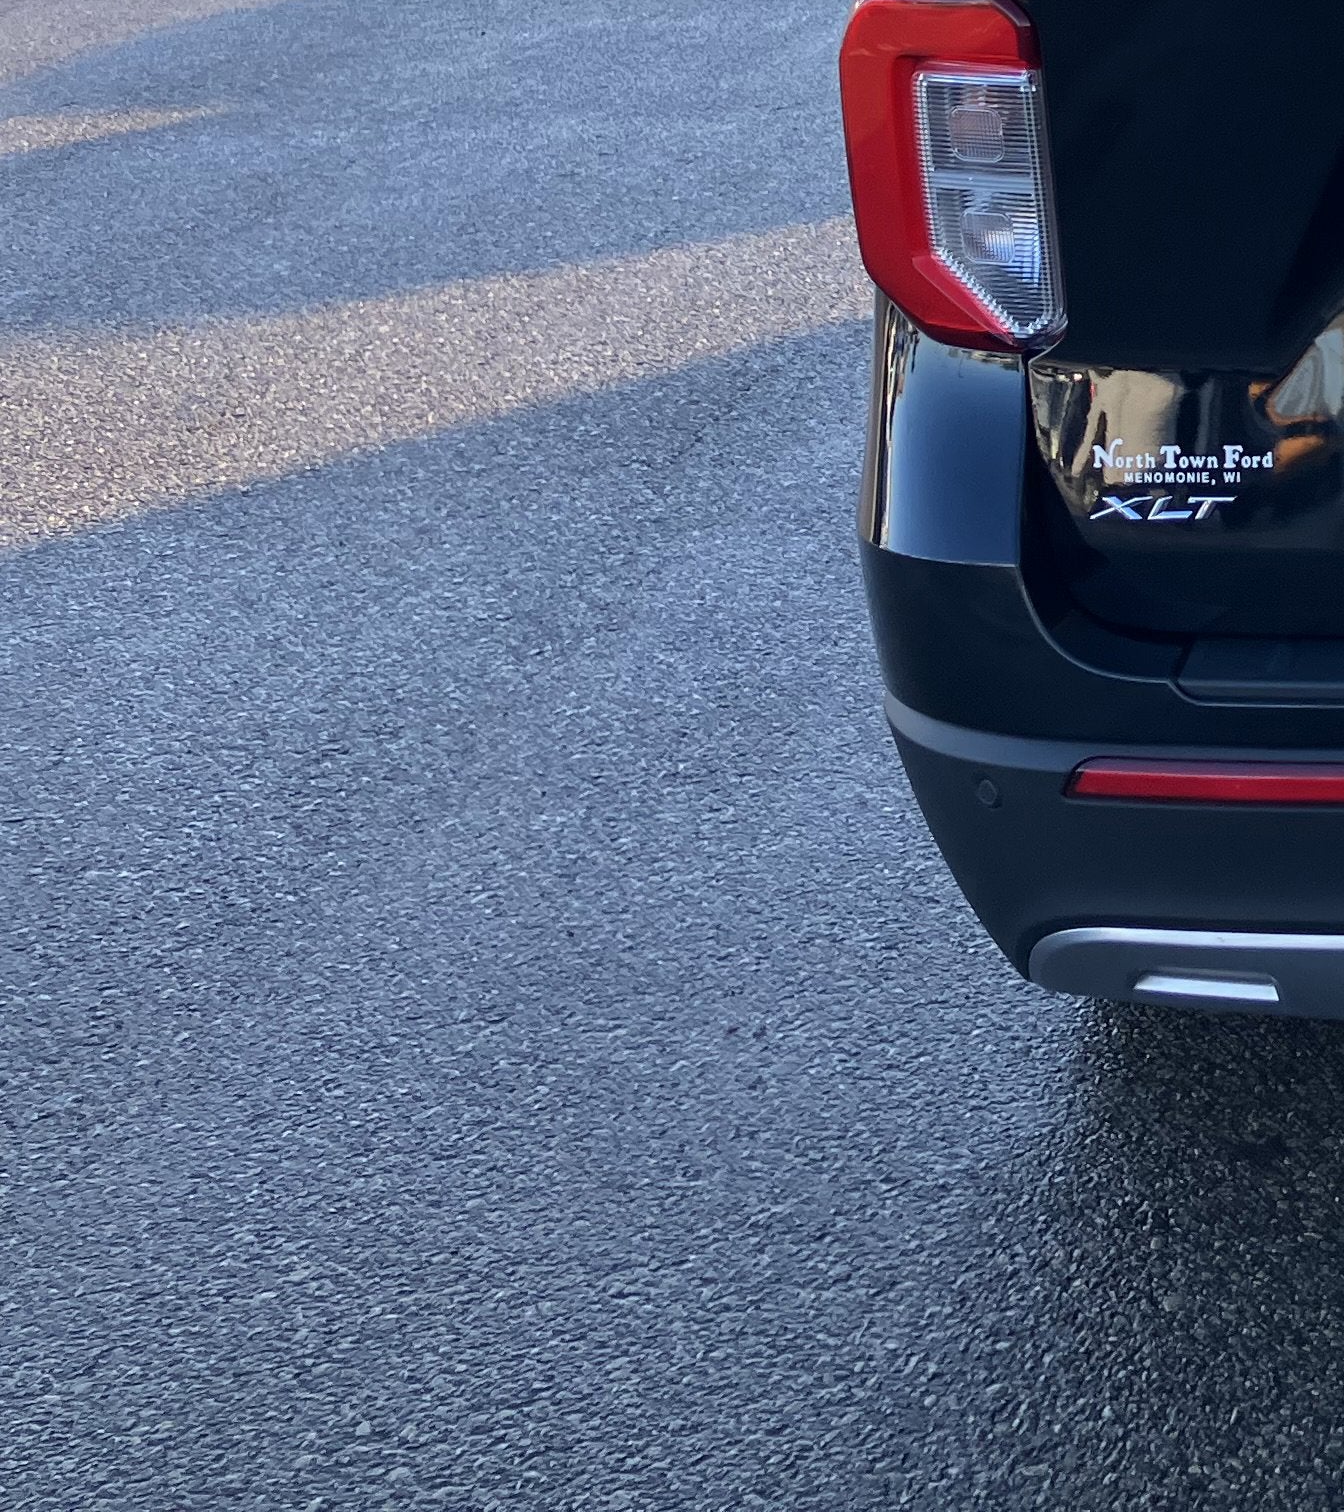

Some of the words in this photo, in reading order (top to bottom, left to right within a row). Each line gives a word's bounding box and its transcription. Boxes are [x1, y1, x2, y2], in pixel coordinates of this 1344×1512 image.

[1092, 438, 1156, 469] North
[1160, 445, 1218, 469] Town
[1223, 445, 1274, 469] Ford
[1124, 472, 1216, 485] MENOMONIE,
[1223, 472, 1241, 483] WI
[1089, 496, 1237, 520] XLT
